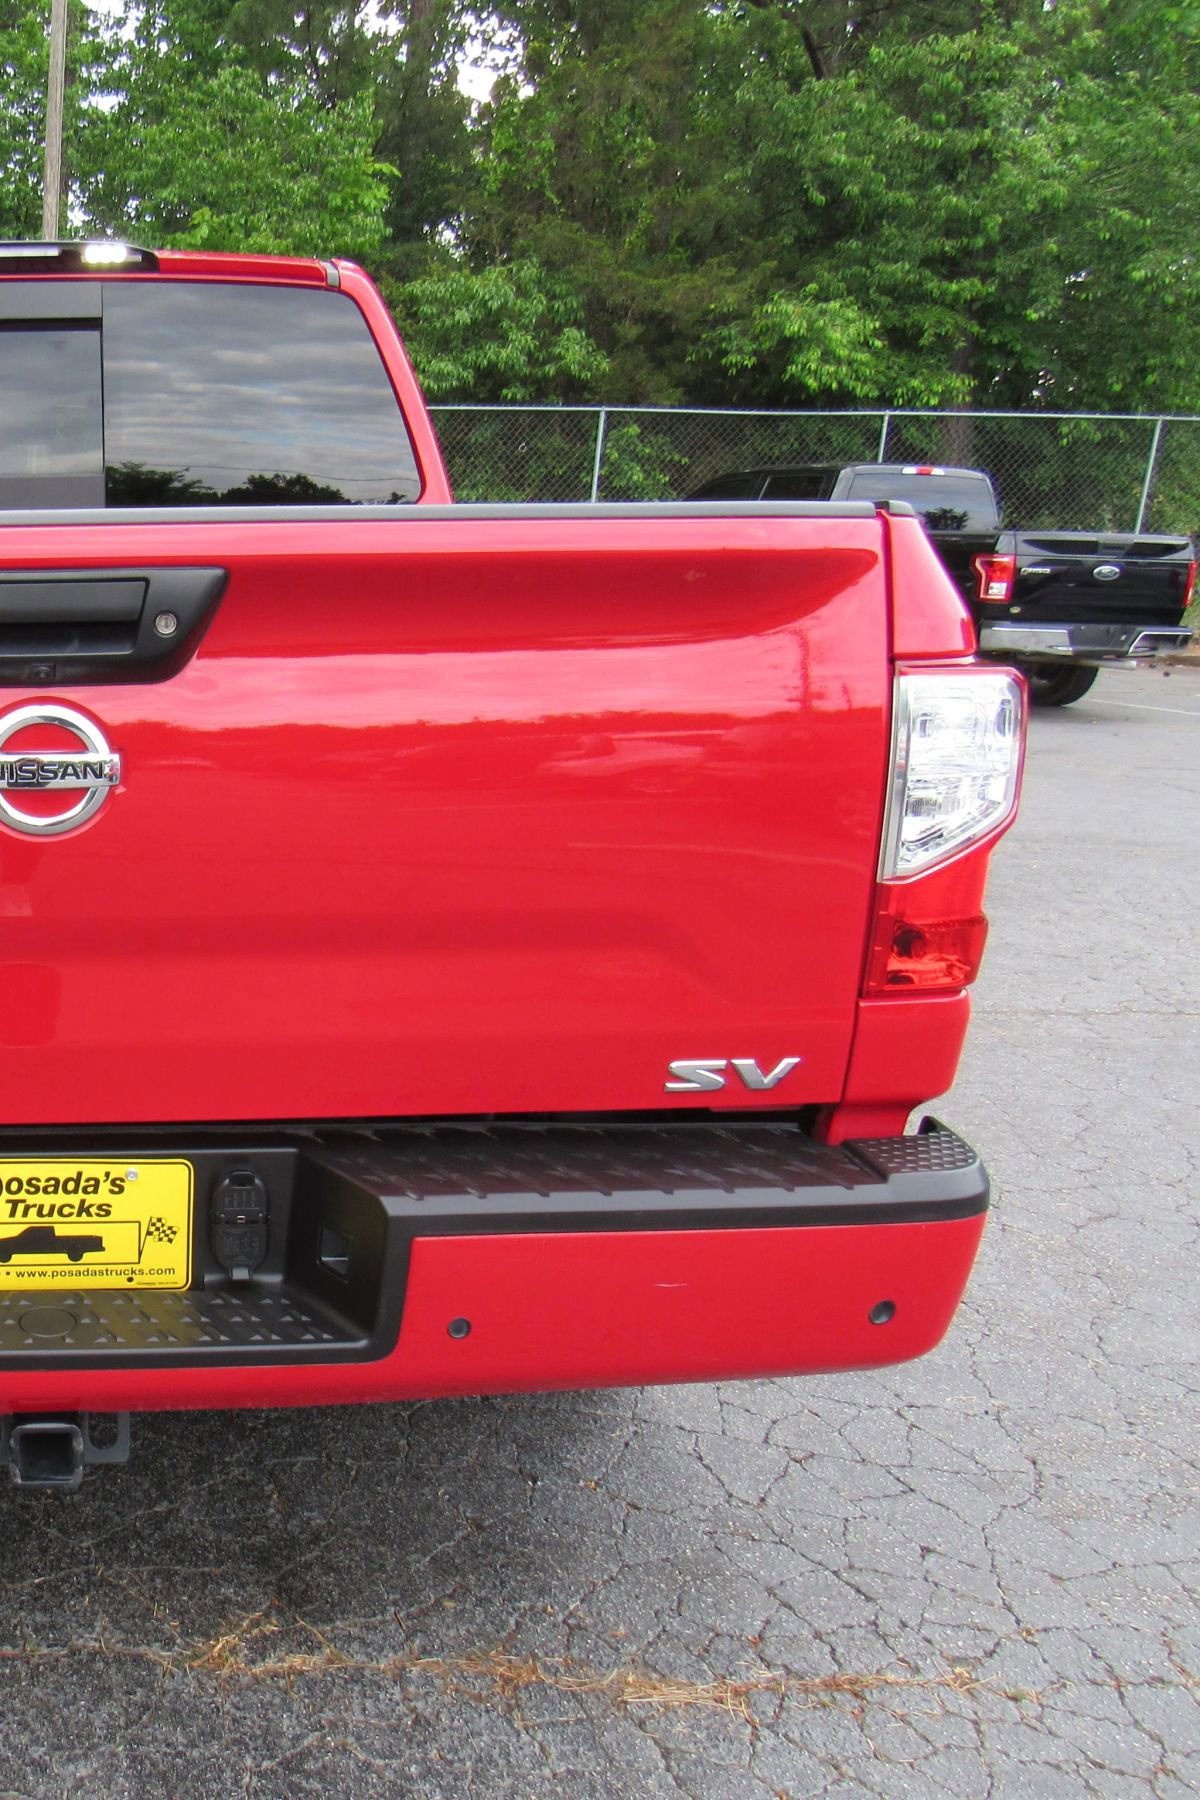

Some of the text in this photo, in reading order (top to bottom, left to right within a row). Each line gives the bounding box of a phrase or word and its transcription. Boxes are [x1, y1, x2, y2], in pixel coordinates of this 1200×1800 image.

[663, 1056, 801, 1093] SV
[5, 1198, 113, 1218] Trucks
[15, 1266, 176, 1279] www.posadastrucks.com
